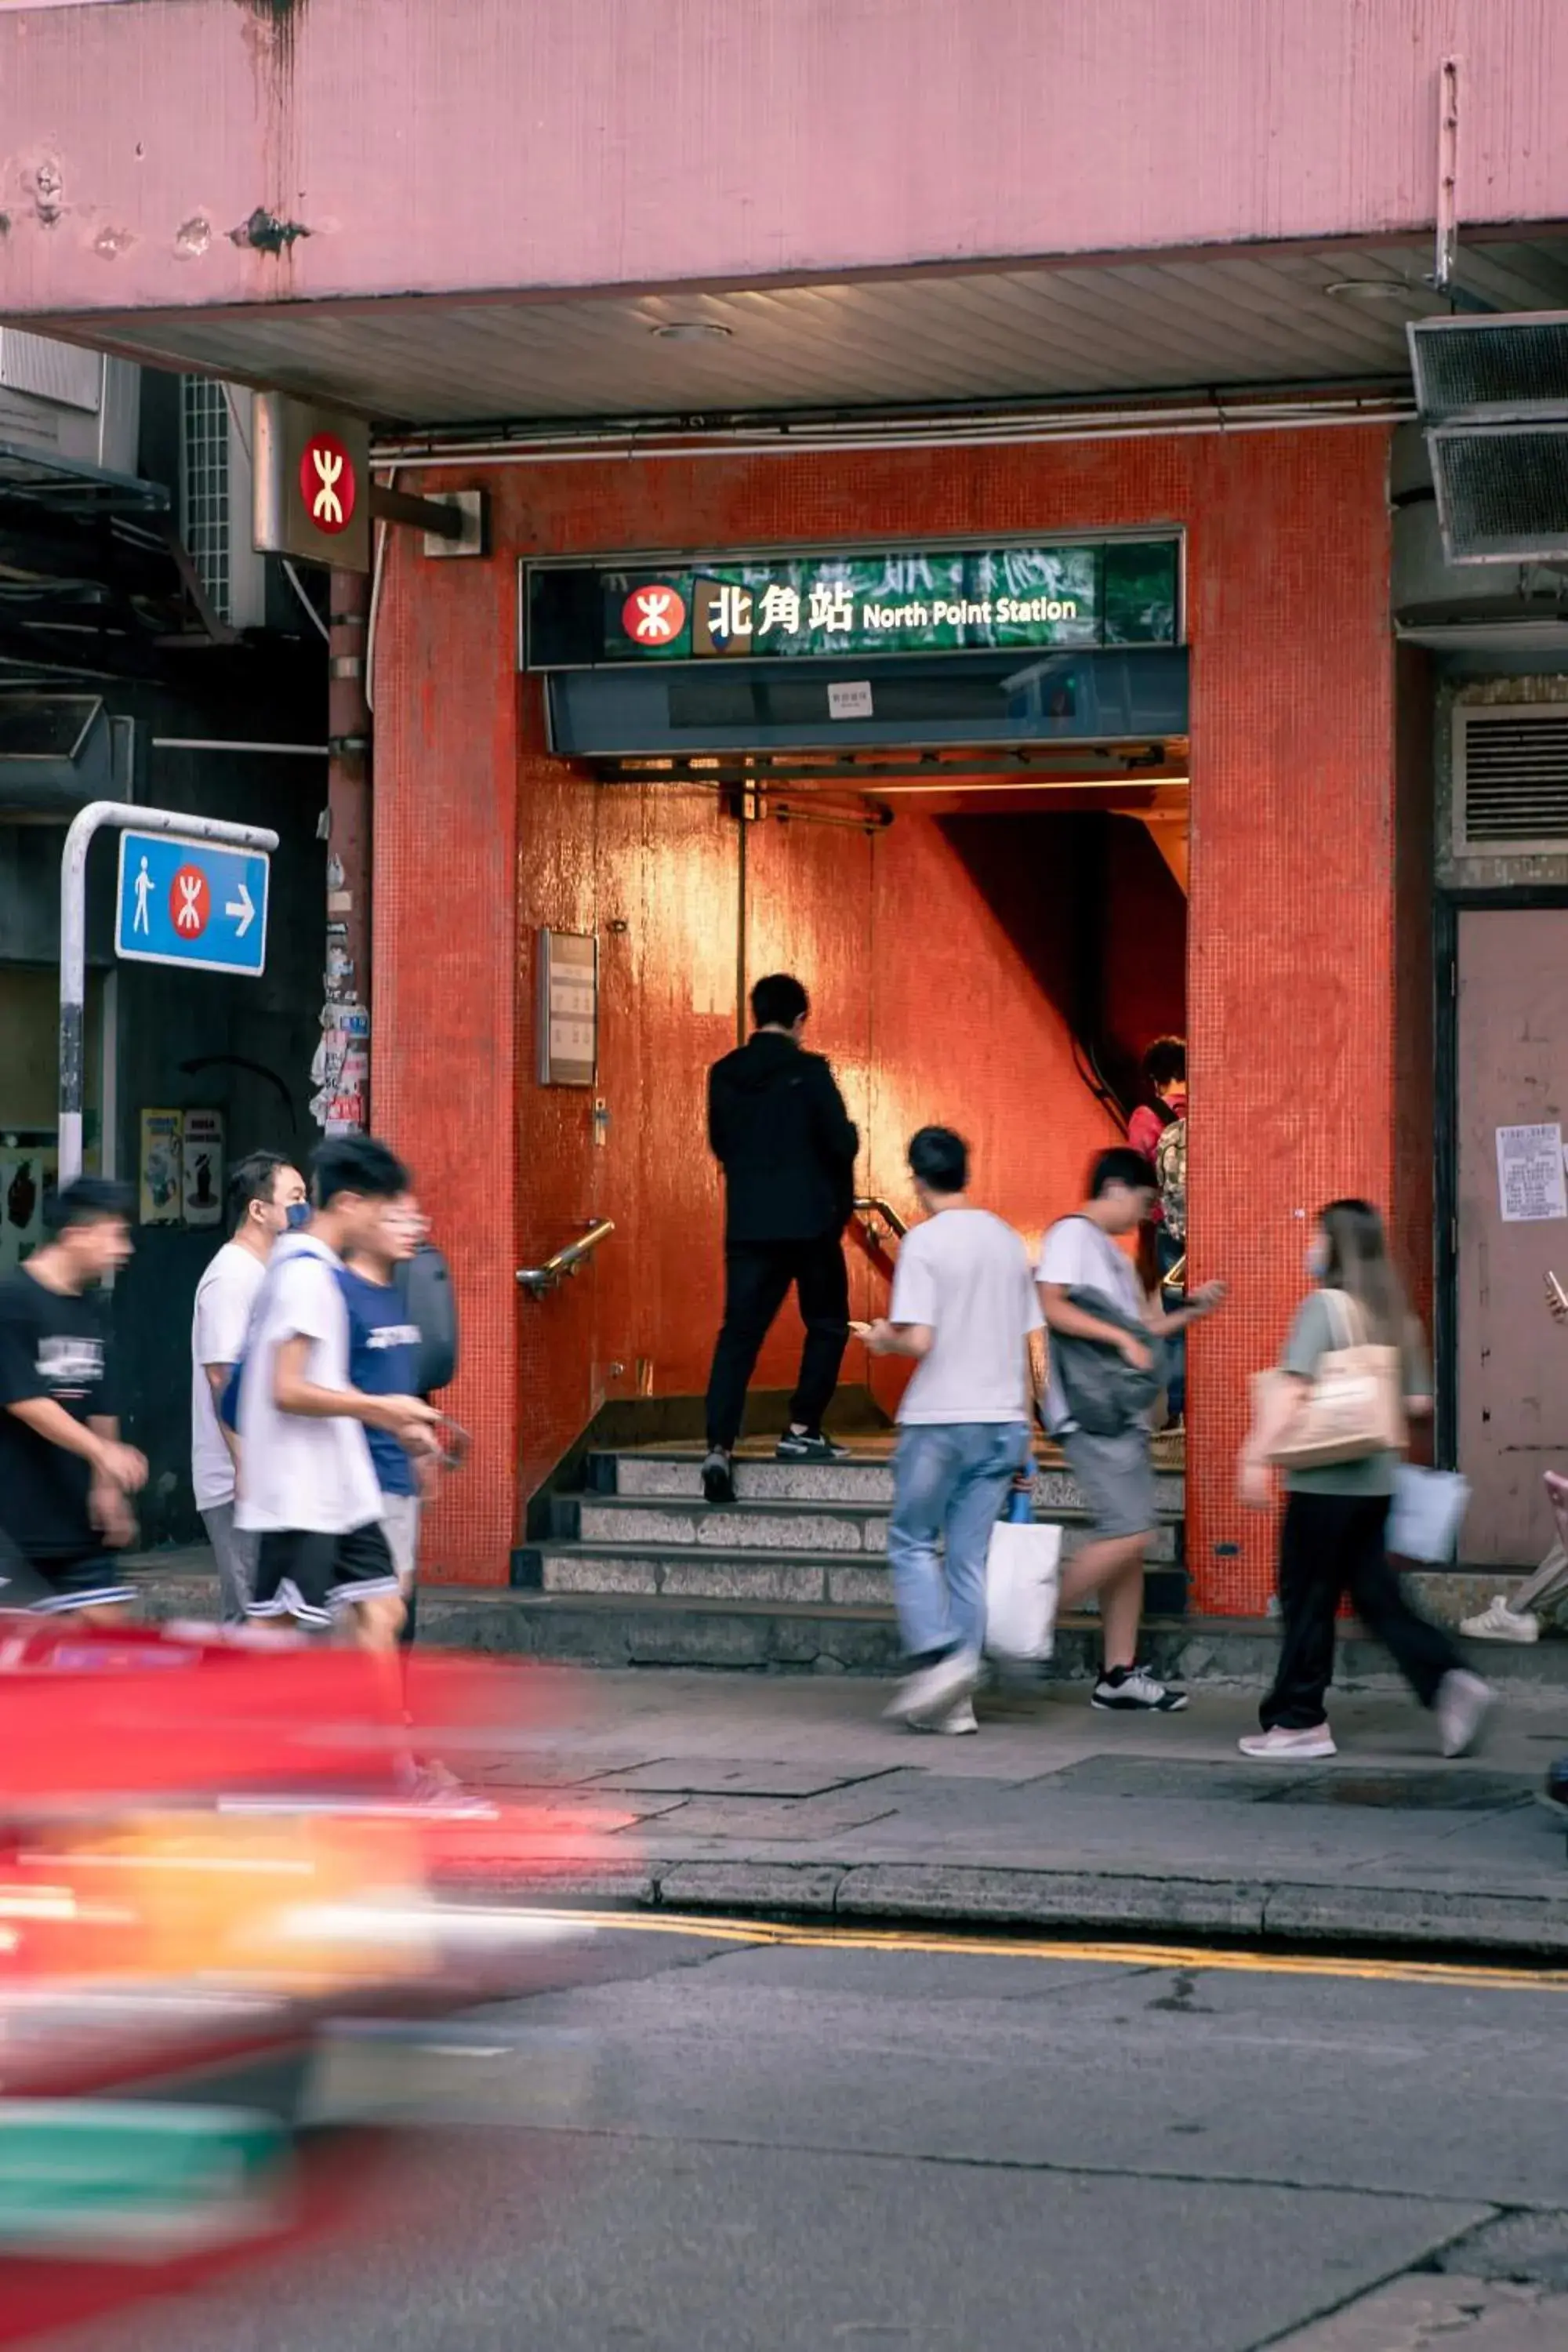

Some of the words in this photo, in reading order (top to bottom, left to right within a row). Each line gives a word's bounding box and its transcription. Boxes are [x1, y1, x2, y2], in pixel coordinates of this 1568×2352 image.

[708, 581, 854, 637] 北角站
[863, 601, 928, 628] North
[934, 600, 992, 625] Point
[996, 597, 1076, 622] Station
